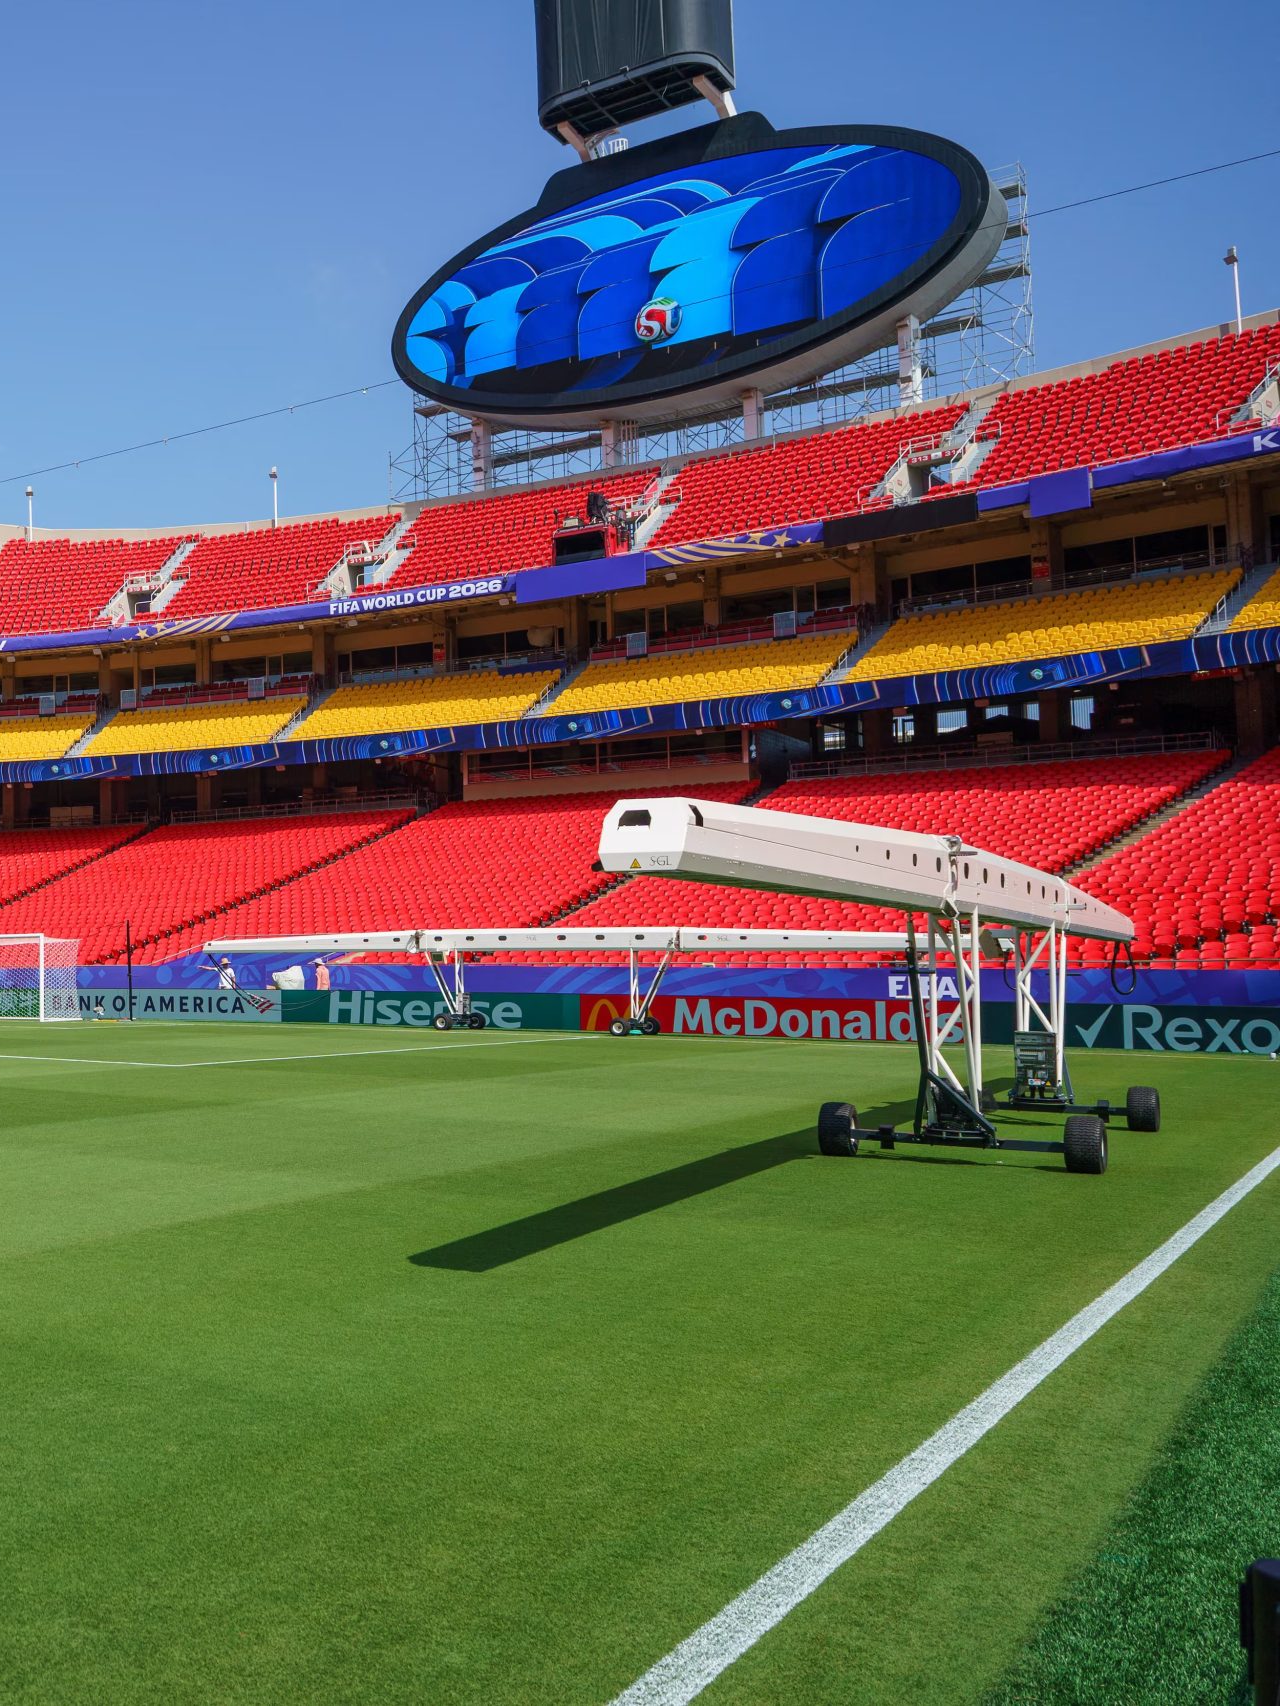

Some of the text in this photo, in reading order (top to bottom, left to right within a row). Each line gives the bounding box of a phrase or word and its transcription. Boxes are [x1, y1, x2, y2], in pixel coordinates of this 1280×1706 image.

[911, 455, 929, 464] 313
[329, 579, 503, 615] FIFA WORLD CUP 2026
[888, 975, 960, 999] FFA
[112, 996, 138, 1012] OF
[143, 995, 246, 1014] AMERICA
[1123, 1004, 1280, 1055] Rexo
